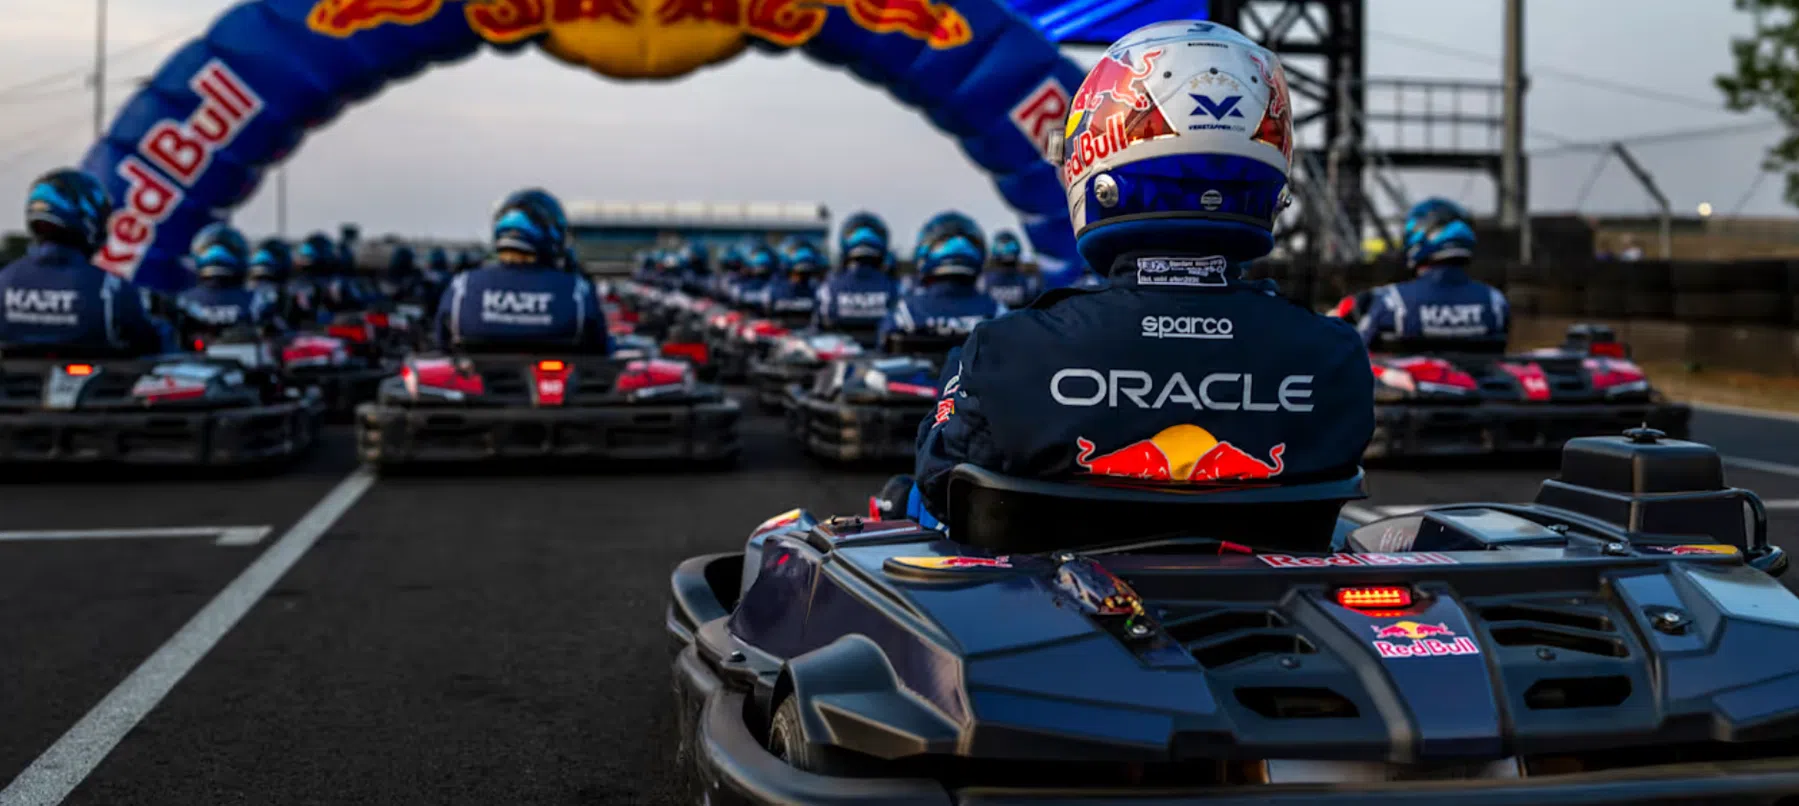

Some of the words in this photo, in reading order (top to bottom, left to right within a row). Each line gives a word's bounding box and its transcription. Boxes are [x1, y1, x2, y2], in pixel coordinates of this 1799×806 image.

[139, 58, 264, 187] Bull
[1080, 111, 1128, 167] Bull
[5, 288, 78, 312] KART
[482, 289, 555, 313] KART
[1420, 304, 1483, 325] KART
[1141, 315, 1234, 339] sparco
[1050, 368, 1314, 412] ORACLE
[1257, 552, 1367, 568] Red
[1353, 552, 1460, 566] Bull
[1372, 639, 1431, 658] Red
[1423, 636, 1480, 656] Bull
